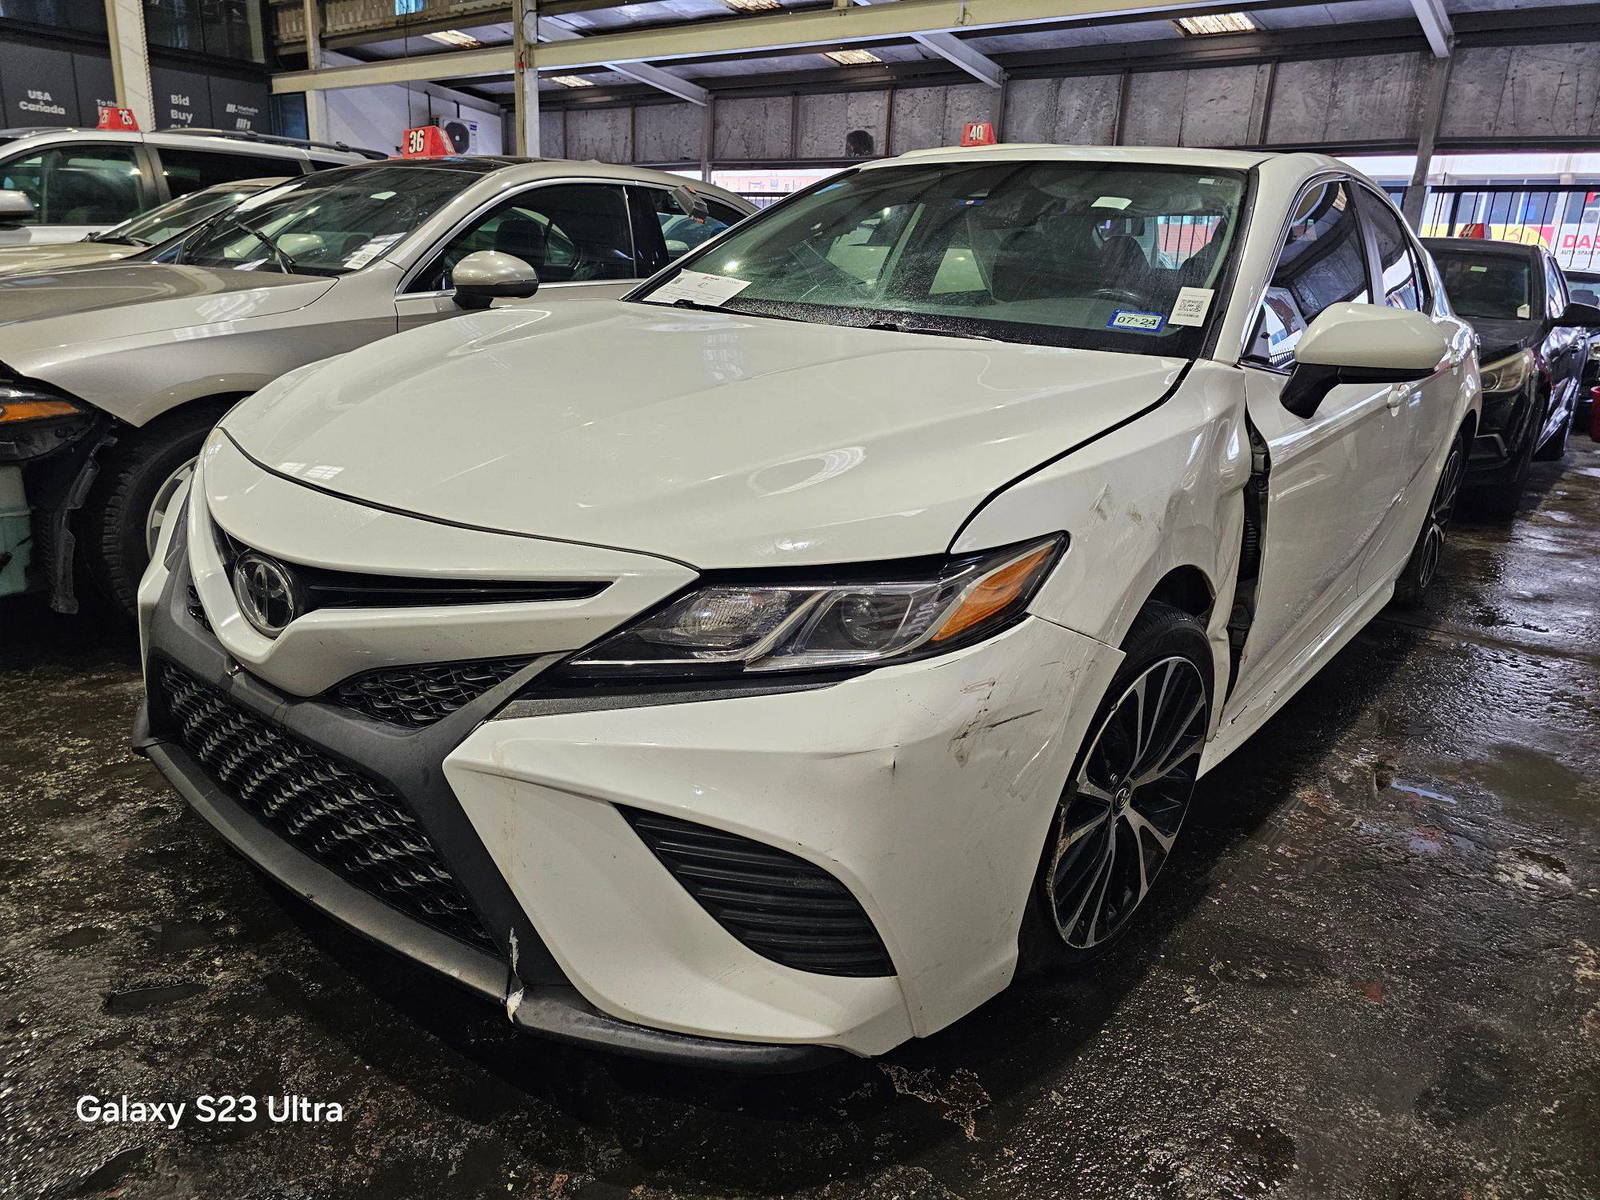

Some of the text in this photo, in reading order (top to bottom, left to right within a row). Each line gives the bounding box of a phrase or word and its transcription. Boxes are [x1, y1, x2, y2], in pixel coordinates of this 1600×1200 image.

[27, 89, 52, 101] USA
[170, 94, 190, 106] Bid
[19, 100, 66, 115] Canada
[170, 109, 193, 124] Buy
[969, 124, 984, 141] 40
[408, 129, 425, 154] 36
